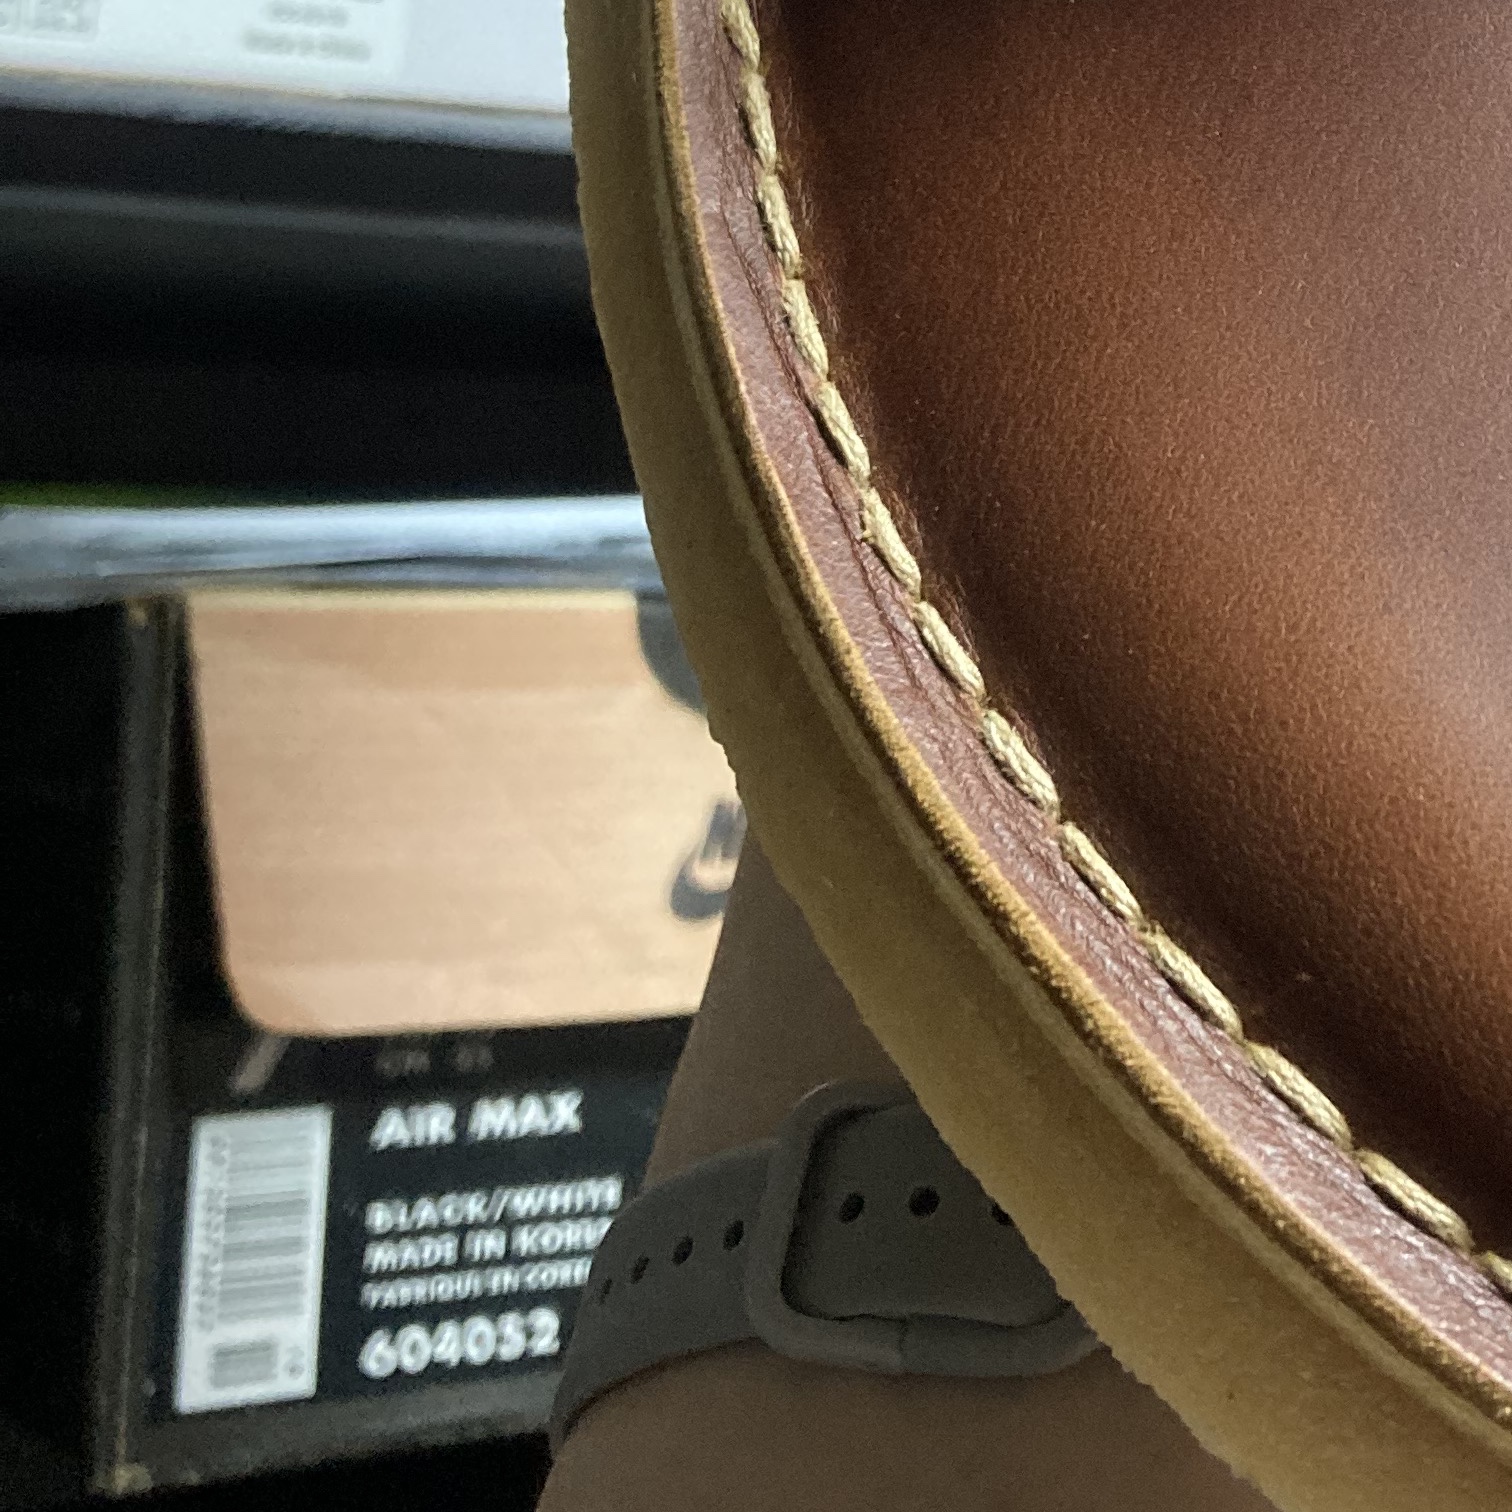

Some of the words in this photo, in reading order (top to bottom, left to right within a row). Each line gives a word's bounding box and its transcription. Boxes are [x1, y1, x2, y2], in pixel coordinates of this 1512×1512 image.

[369, 1100, 457, 1151] AIR
[467, 1088, 584, 1141] MAX
[362, 1233, 459, 1274] MADE
[462, 1227, 507, 1263] IN
